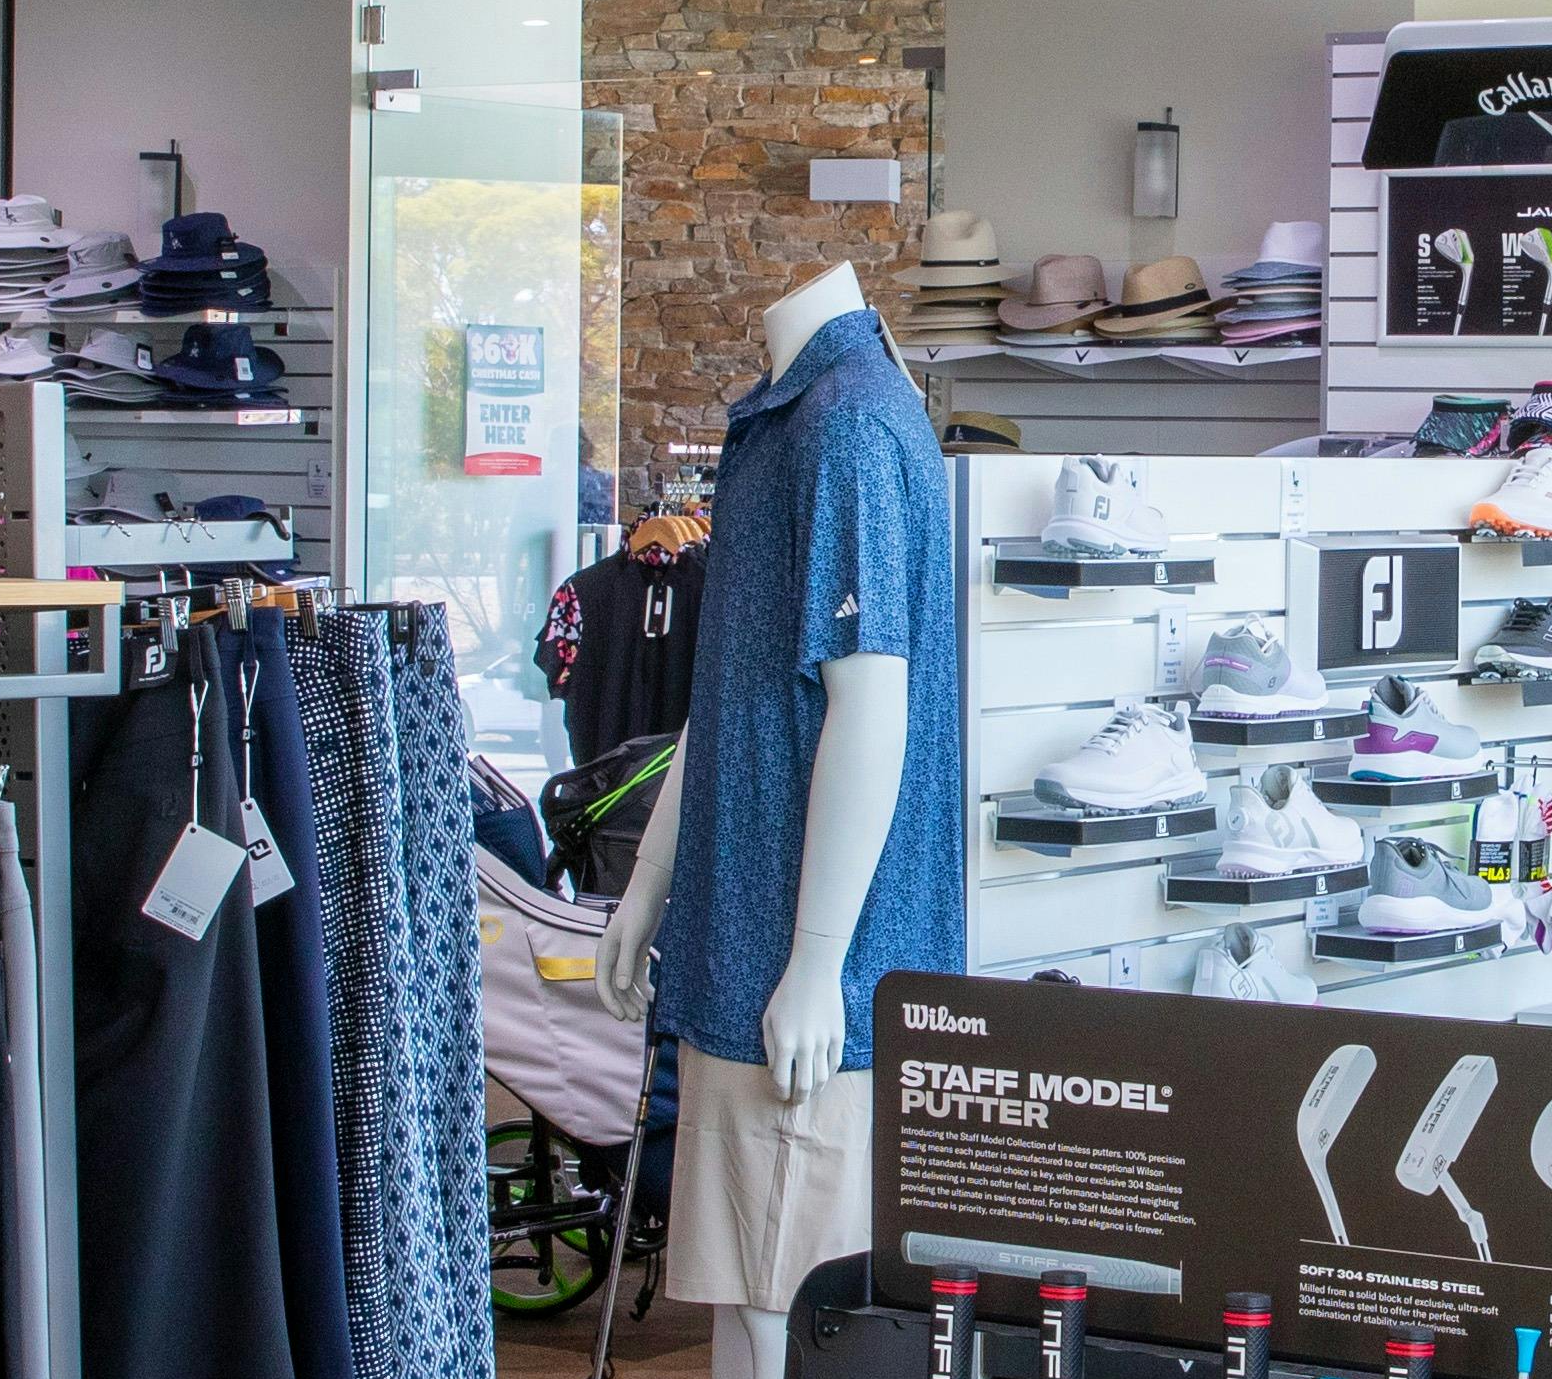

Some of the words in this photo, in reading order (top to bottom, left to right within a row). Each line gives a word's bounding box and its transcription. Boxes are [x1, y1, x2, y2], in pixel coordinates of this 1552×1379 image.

[1417, 233, 1431, 257] S
[1501, 232, 1524, 257] W
[471, 367, 517, 381] CHRISTMAS
[518, 370, 540, 381] CASH
[479, 403, 531, 424] ENTER
[484, 426, 527, 445] HERE
[1093, 494, 1111, 520] FJ
[1362, 555, 1403, 650] FJ
[902, 1002, 988, 1036] Wilson
[899, 1059, 1019, 1096] STAFF
[901, 1087, 1049, 1129] PUTTER
[901, 1125, 945, 1140] Introducing
[946, 1131, 959, 1140] the
[960, 1131, 980, 1142] Staff
[981, 1134, 1005, 1145] Model
[1006, 1137, 1047, 1149] Collection
[1047, 1141, 1057, 1150] of
[1057, 1143, 1091, 1154] timeless
[1092, 1148, 1124, 1158] putters.
[1125, 1150, 1148, 1160] 100%
[1148, 1154, 1186, 1164] precision
[1299, 1264, 1335, 1277] SOFT
[1337, 1268, 1364, 1280] 304
[1366, 1272, 1439, 1289] STAINLESS
[1441, 1281, 1485, 1295] STEEL
[1300, 1283, 1326, 1293] Milled
[1327, 1286, 1347, 1296] from
[1356, 1290, 1377, 1300] solid
[1379, 1292, 1402, 1303] block
[1404, 1295, 1413, 1304] of
[1414, 1298, 1457, 1310] exclusive,
[1458, 1302, 1499, 1315] ultra-soft
